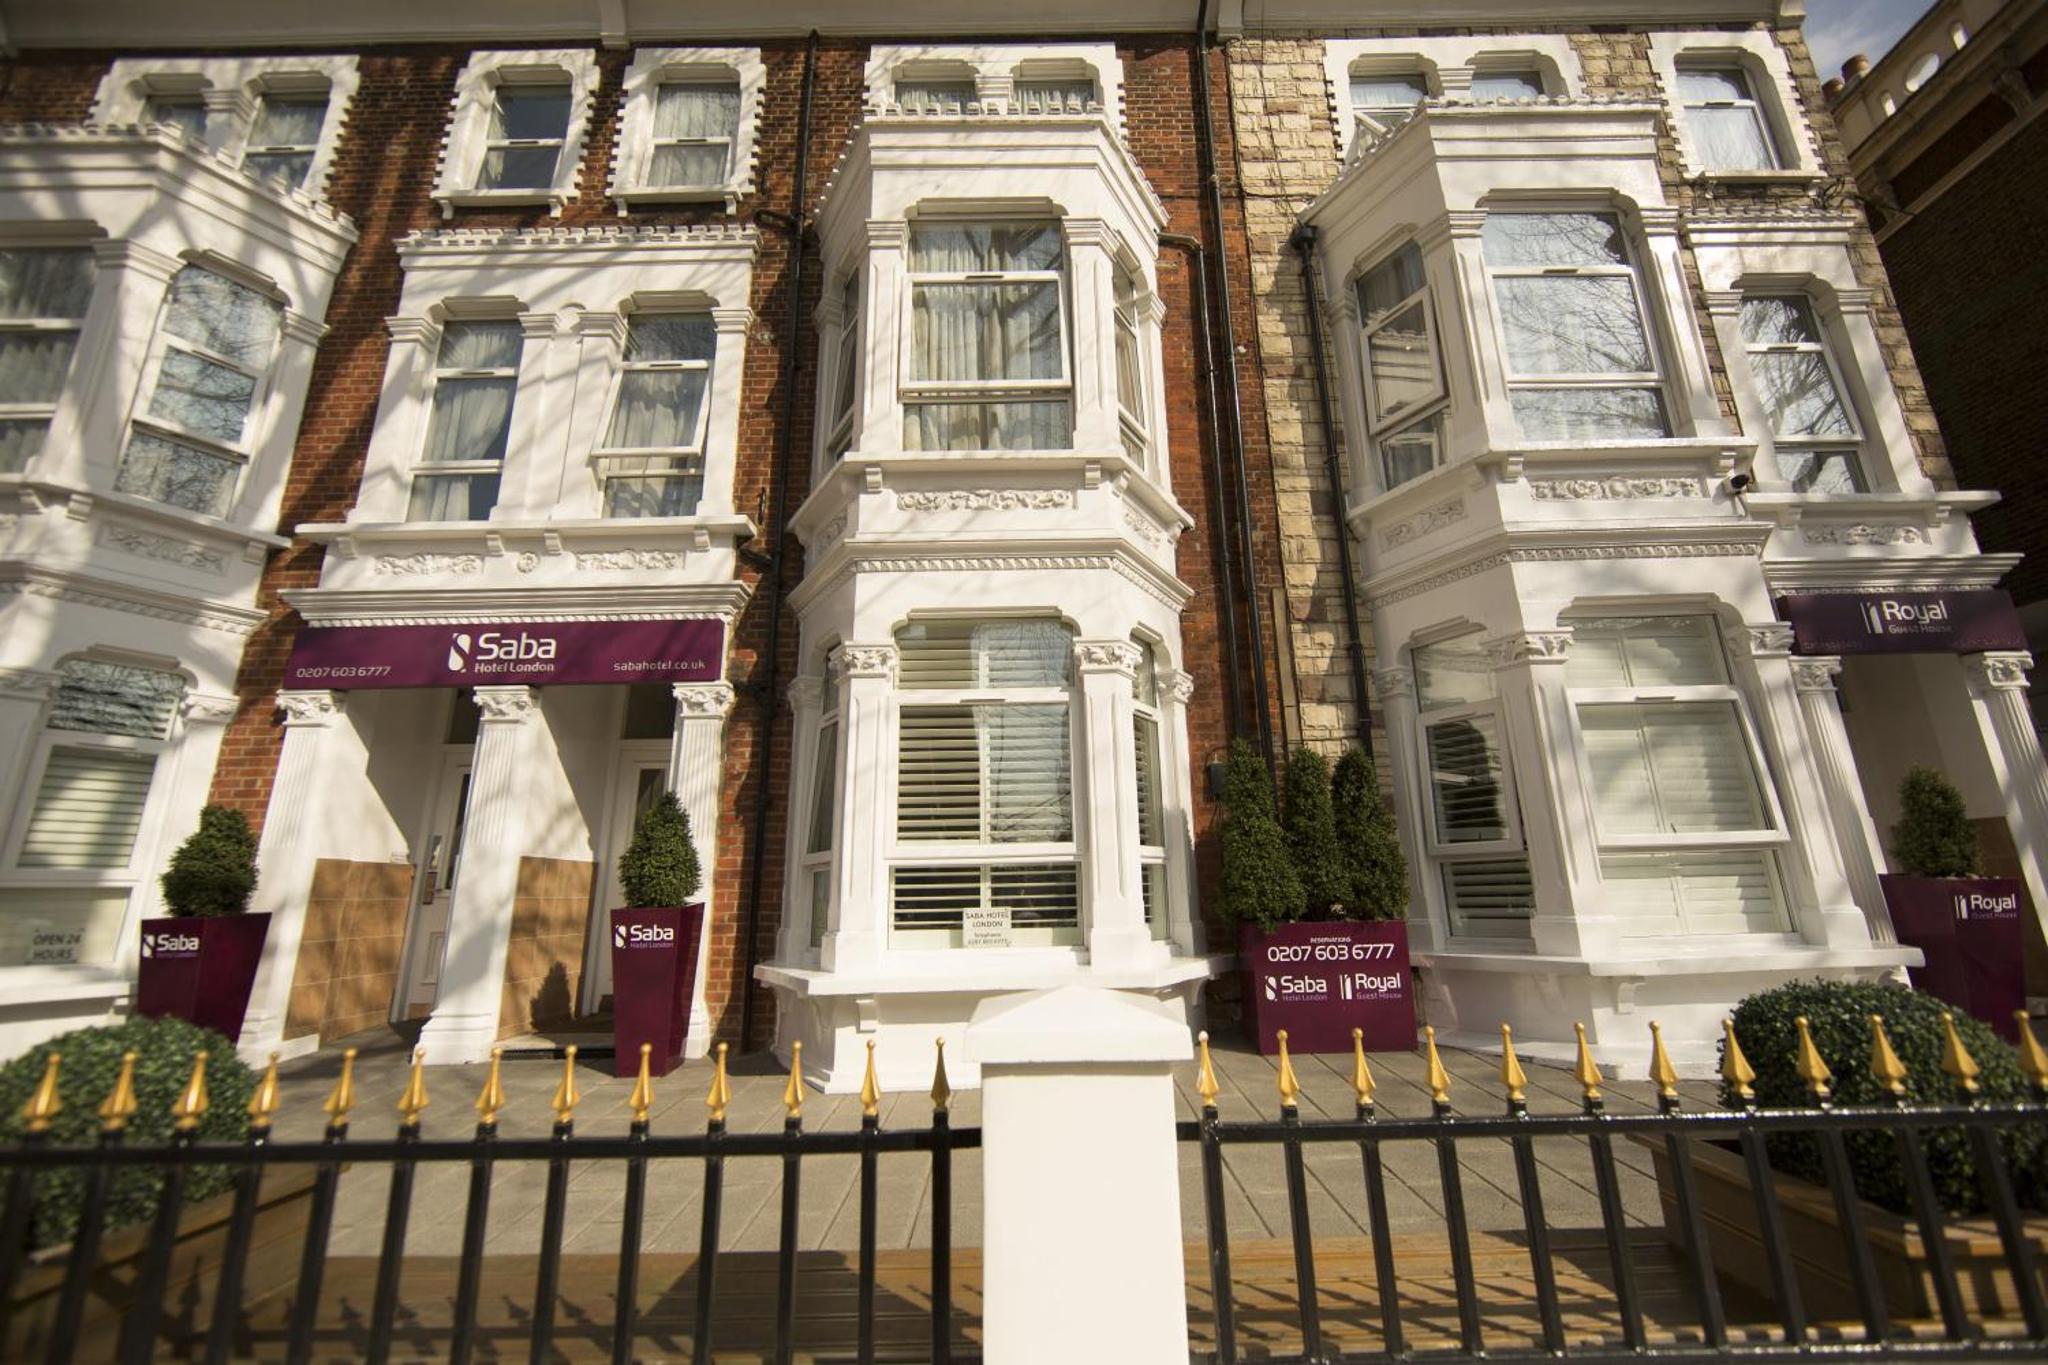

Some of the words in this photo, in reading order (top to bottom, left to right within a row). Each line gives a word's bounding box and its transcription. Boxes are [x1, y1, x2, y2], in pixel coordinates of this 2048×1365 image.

[1882, 600, 1948, 624] Royal
[476, 632, 557, 660] Saba
[474, 662, 508, 673] Hotel
[509, 662, 554, 673] London
[613, 660, 706, 671] sabahotel.co.uk
[1970, 893, 2016, 912] Royal
[33, 934, 64, 946] OPEN
[630, 924, 674, 941] Saba
[156, 934, 200, 951] Saba
[33, 949, 73, 960] HOURS
[1267, 946, 1311, 962] 0207
[1315, 945, 1349, 961] 603
[1352, 943, 1395, 960] 6777
[1280, 975, 1328, 993] Saba
[1355, 972, 1402, 992] Royal
